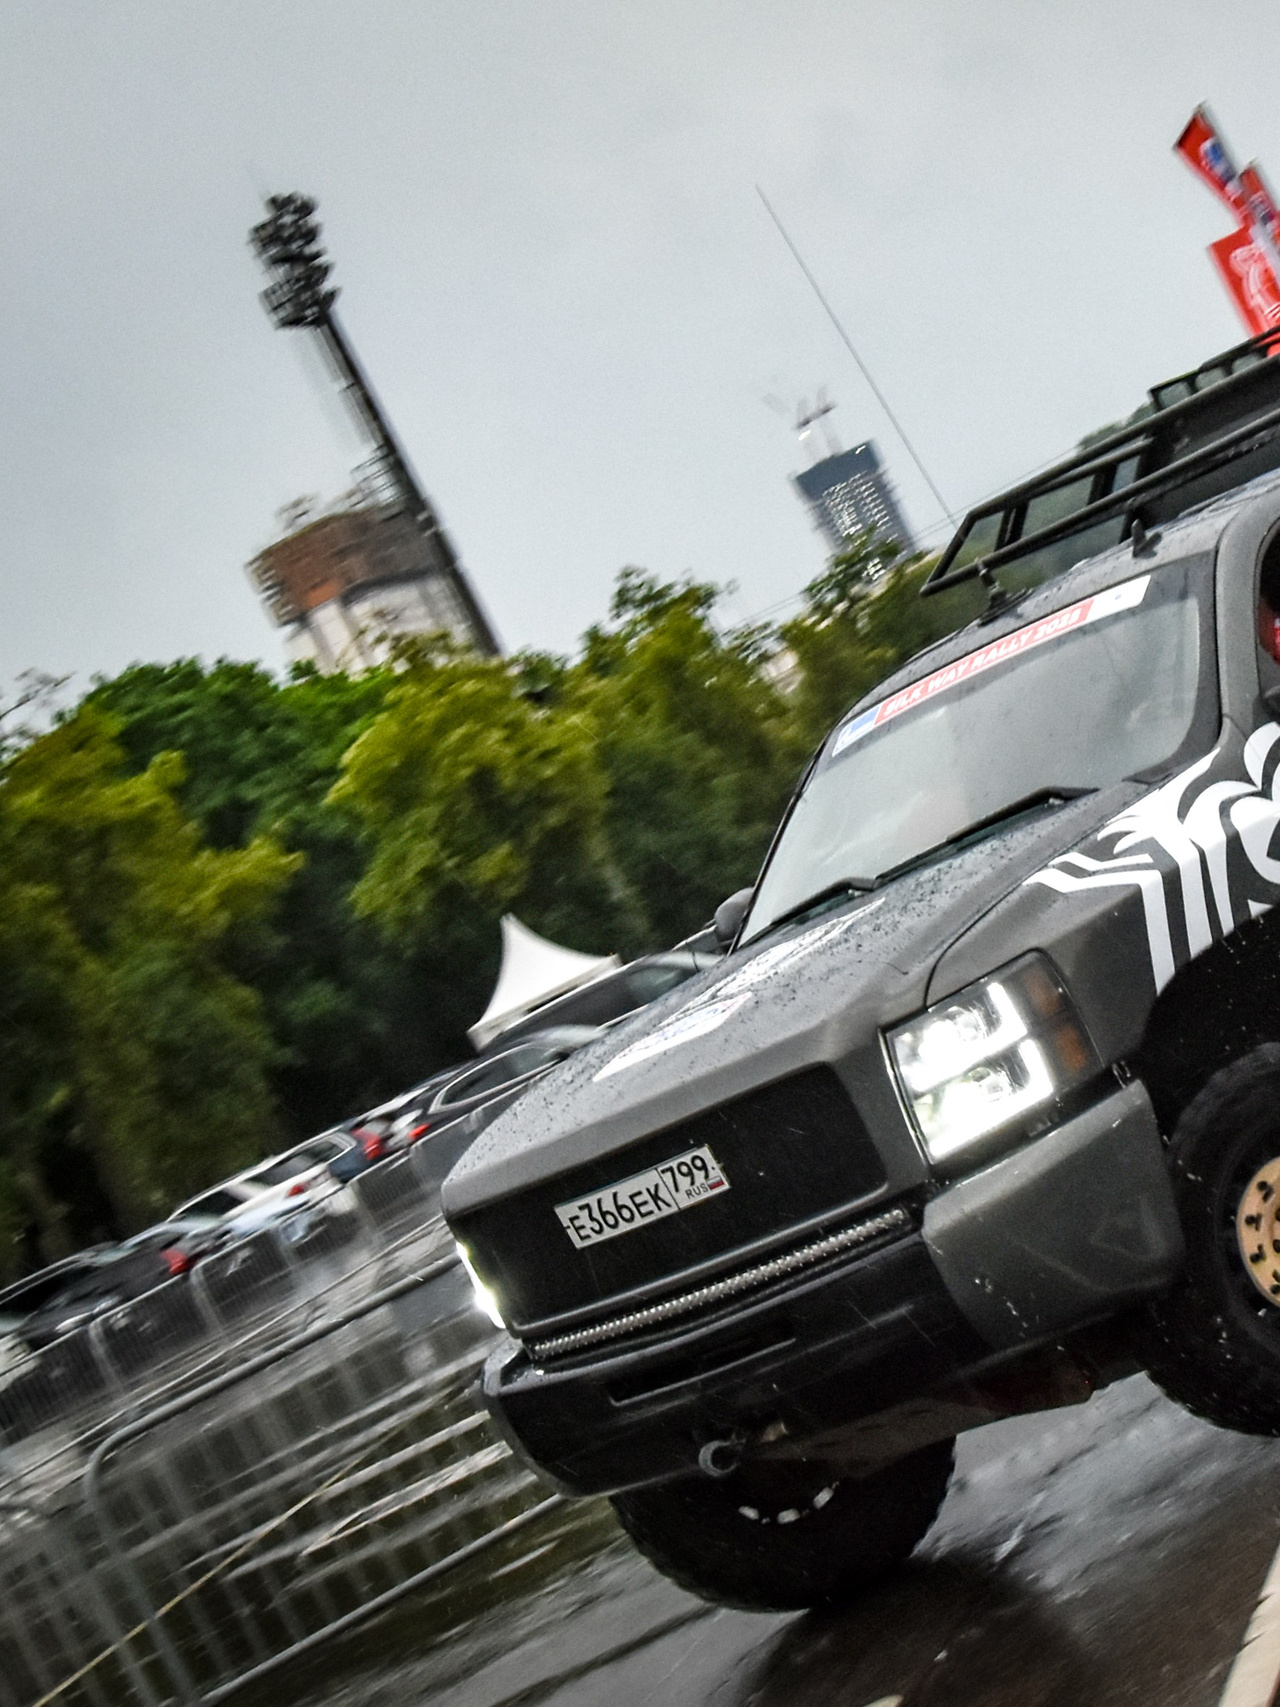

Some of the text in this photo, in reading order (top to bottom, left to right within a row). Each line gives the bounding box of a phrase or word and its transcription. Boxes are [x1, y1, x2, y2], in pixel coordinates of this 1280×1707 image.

[884, 686, 922, 717] SILK
[928, 659, 968, 691] WAY
[971, 629, 1034, 669] RALLY
[661, 1154, 710, 1194] 799
[685, 1183, 709, 1199] RUS
